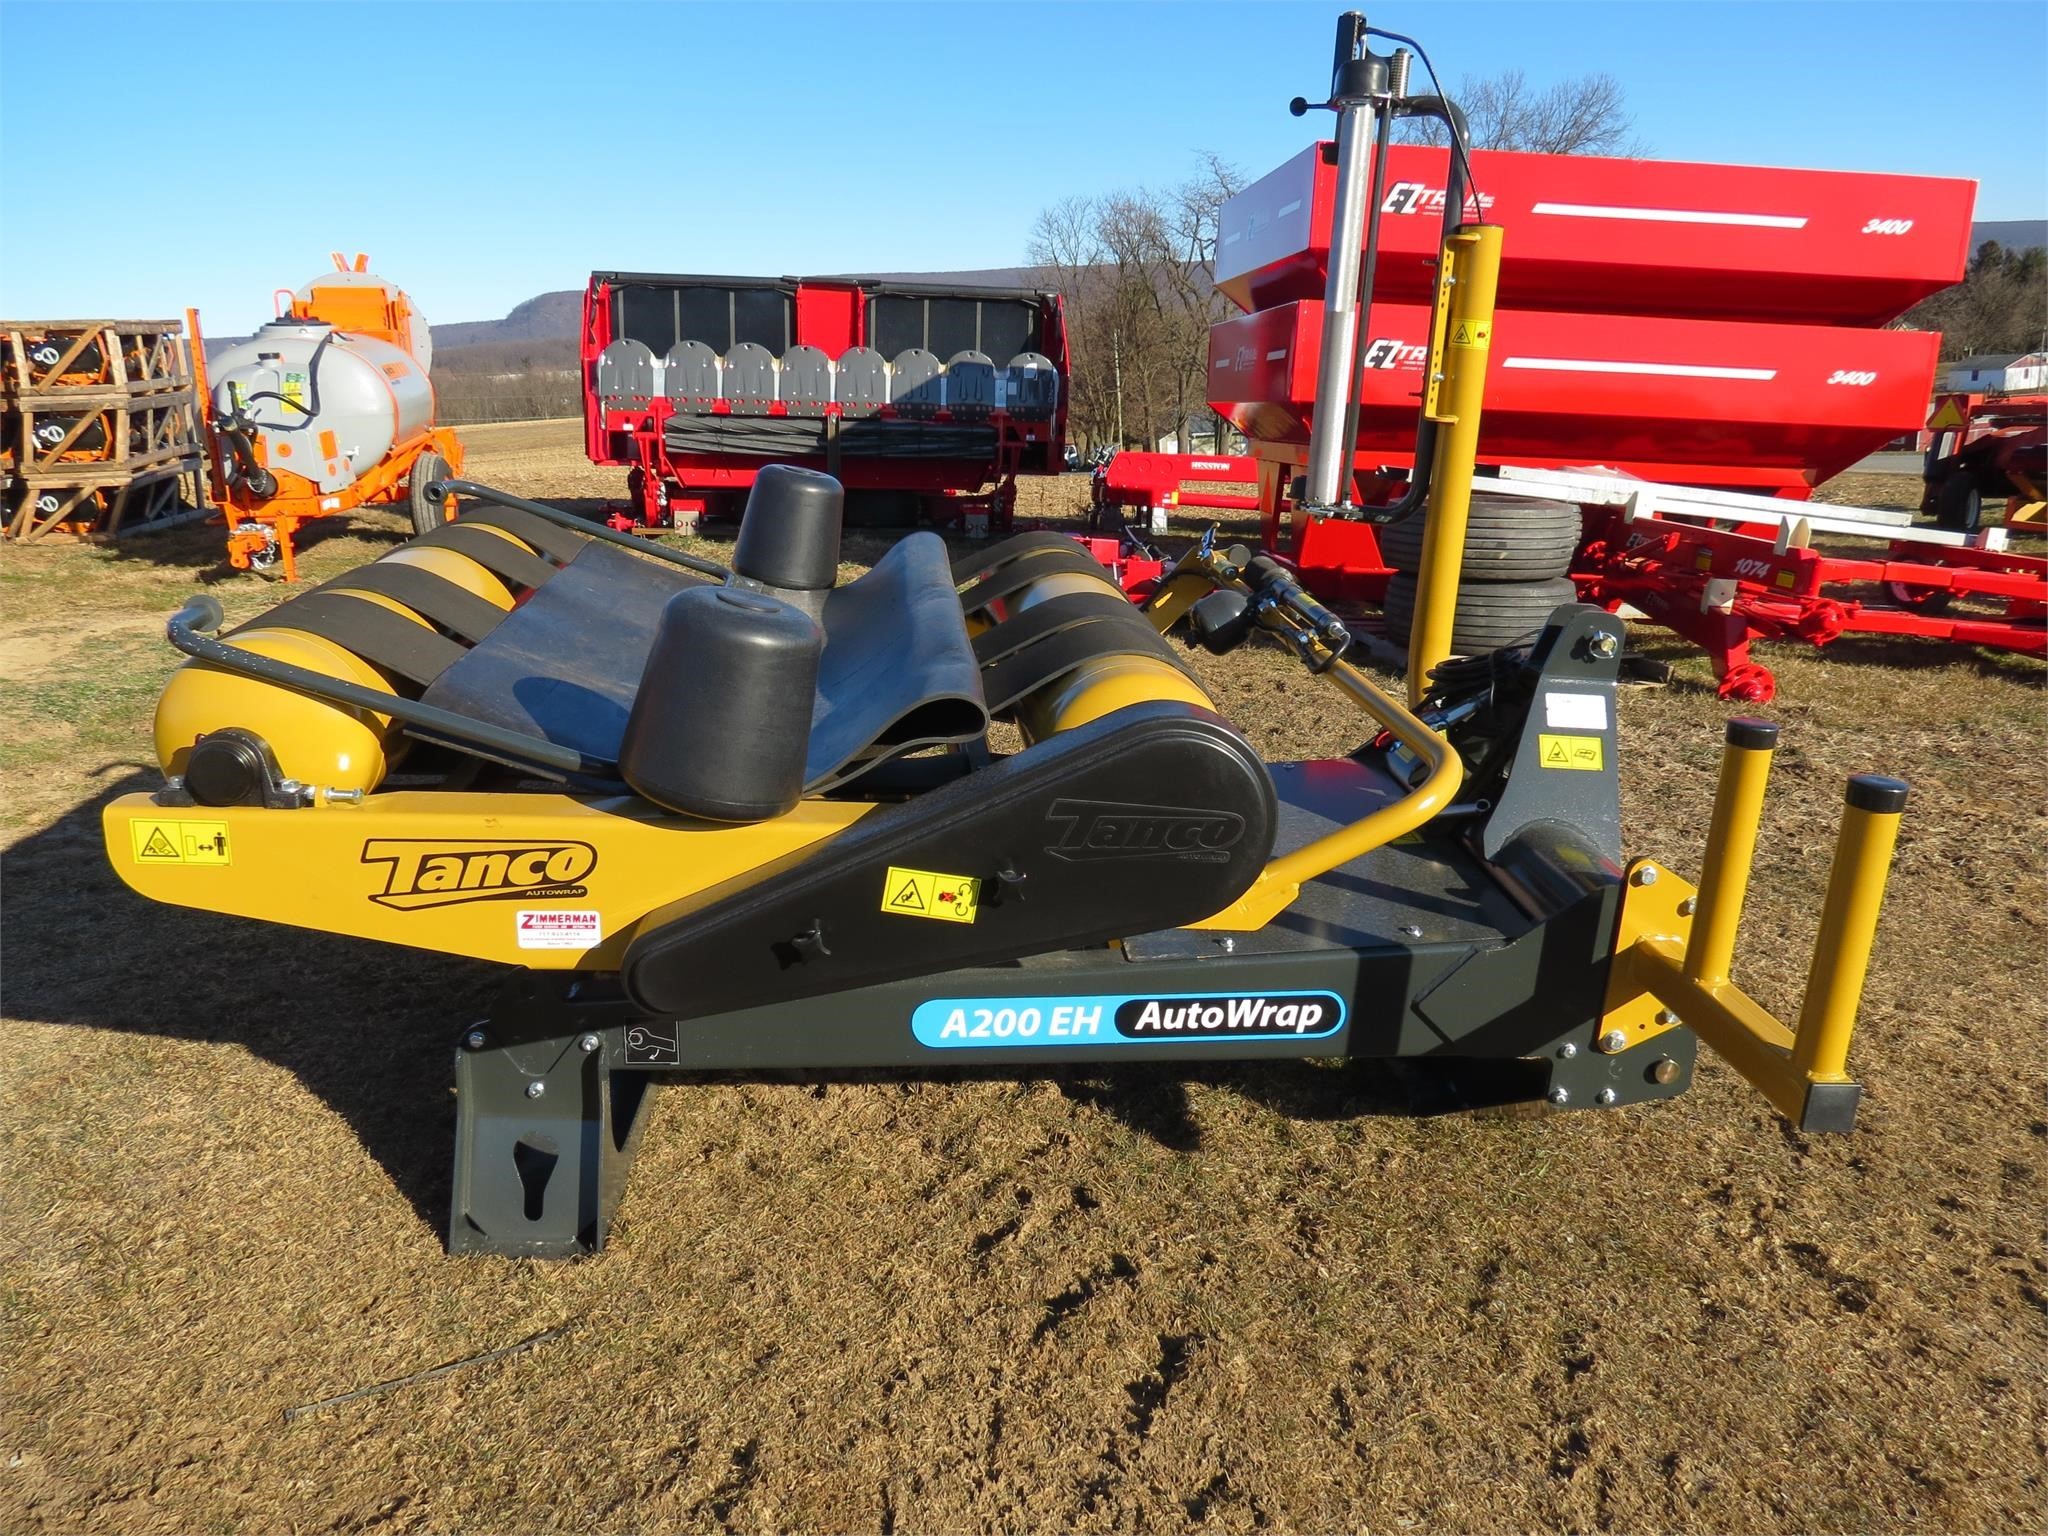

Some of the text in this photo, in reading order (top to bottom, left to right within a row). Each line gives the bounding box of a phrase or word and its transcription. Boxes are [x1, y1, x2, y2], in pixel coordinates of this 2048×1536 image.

[1861, 218, 1914, 235] 3400
[1826, 369, 1877, 386] 3400
[1733, 558, 1771, 578] 1074
[1045, 798, 1246, 851] Tanco
[361, 839, 598, 896] Tanco
[525, 888, 585, 897] AUTOWRAP
[521, 914, 596, 929] ZIMMERMAN
[939, 999, 1322, 1038] A200 EH AutoWrap
